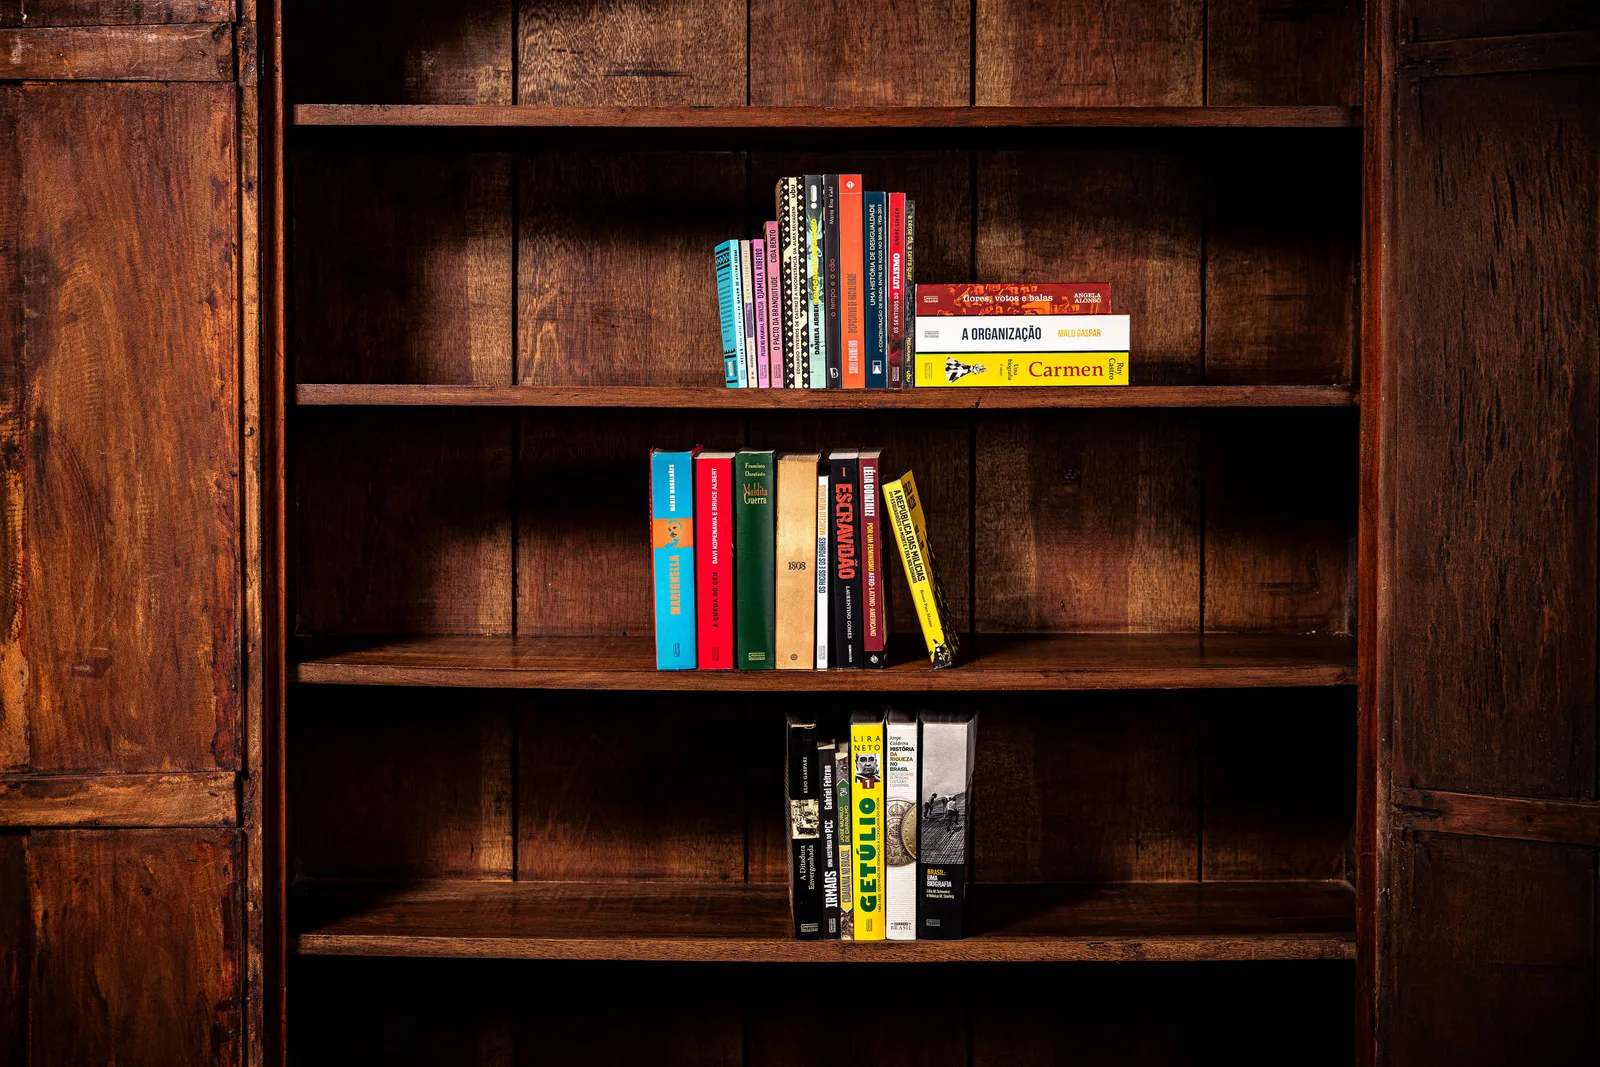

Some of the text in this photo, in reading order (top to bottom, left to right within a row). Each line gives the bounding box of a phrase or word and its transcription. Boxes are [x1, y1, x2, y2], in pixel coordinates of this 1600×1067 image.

[755, 248, 763, 270] RIBEIRO
[792, 247, 797, 255] DA
[870, 252, 875, 260] DE
[892, 253, 900, 289] LULISMO
[756, 272, 764, 299] DJAMILA
[829, 289, 837, 310] tempo
[962, 294, 992, 302] flores,
[995, 294, 1019, 302] votos
[1028, 294, 1053, 302] balas
[772, 317, 779, 325] DA
[961, 324, 1041, 342] A ORGANIZAÇÃO
[1057, 329, 1101, 337] MALU GASPAR
[1028, 361, 1103, 378] Carmen
[1115, 362, 1124, 375] Ruy
[743, 482, 768, 496] Maldita
[743, 491, 767, 504] Guerra
[863, 466, 876, 517] LÉLIA GONZALEZ
[836, 483, 858, 579] ESCRAVIDÃO
[867, 534, 874, 543] UM
[896, 495, 912, 534] REPÚBLICA
[910, 551, 925, 582] MILÍCIAS
[899, 532, 907, 547] MORTE
[788, 561, 806, 570] 1808
[818, 570, 826, 585] RICOS
[712, 588, 718, 596] DO
[823, 765, 832, 787] Feltran
[865, 780, 871, 788] 1
[823, 788, 832, 810] Gabriel
[825, 820, 833, 833] PCC
[839, 850, 850, 867] BRASIL
[856, 798, 877, 912] GETÚLIO
[807, 845, 816, 890] Envergonhada
[824, 871, 838, 908] IRMÃOS
[841, 875, 851, 903] CIDADANIA
